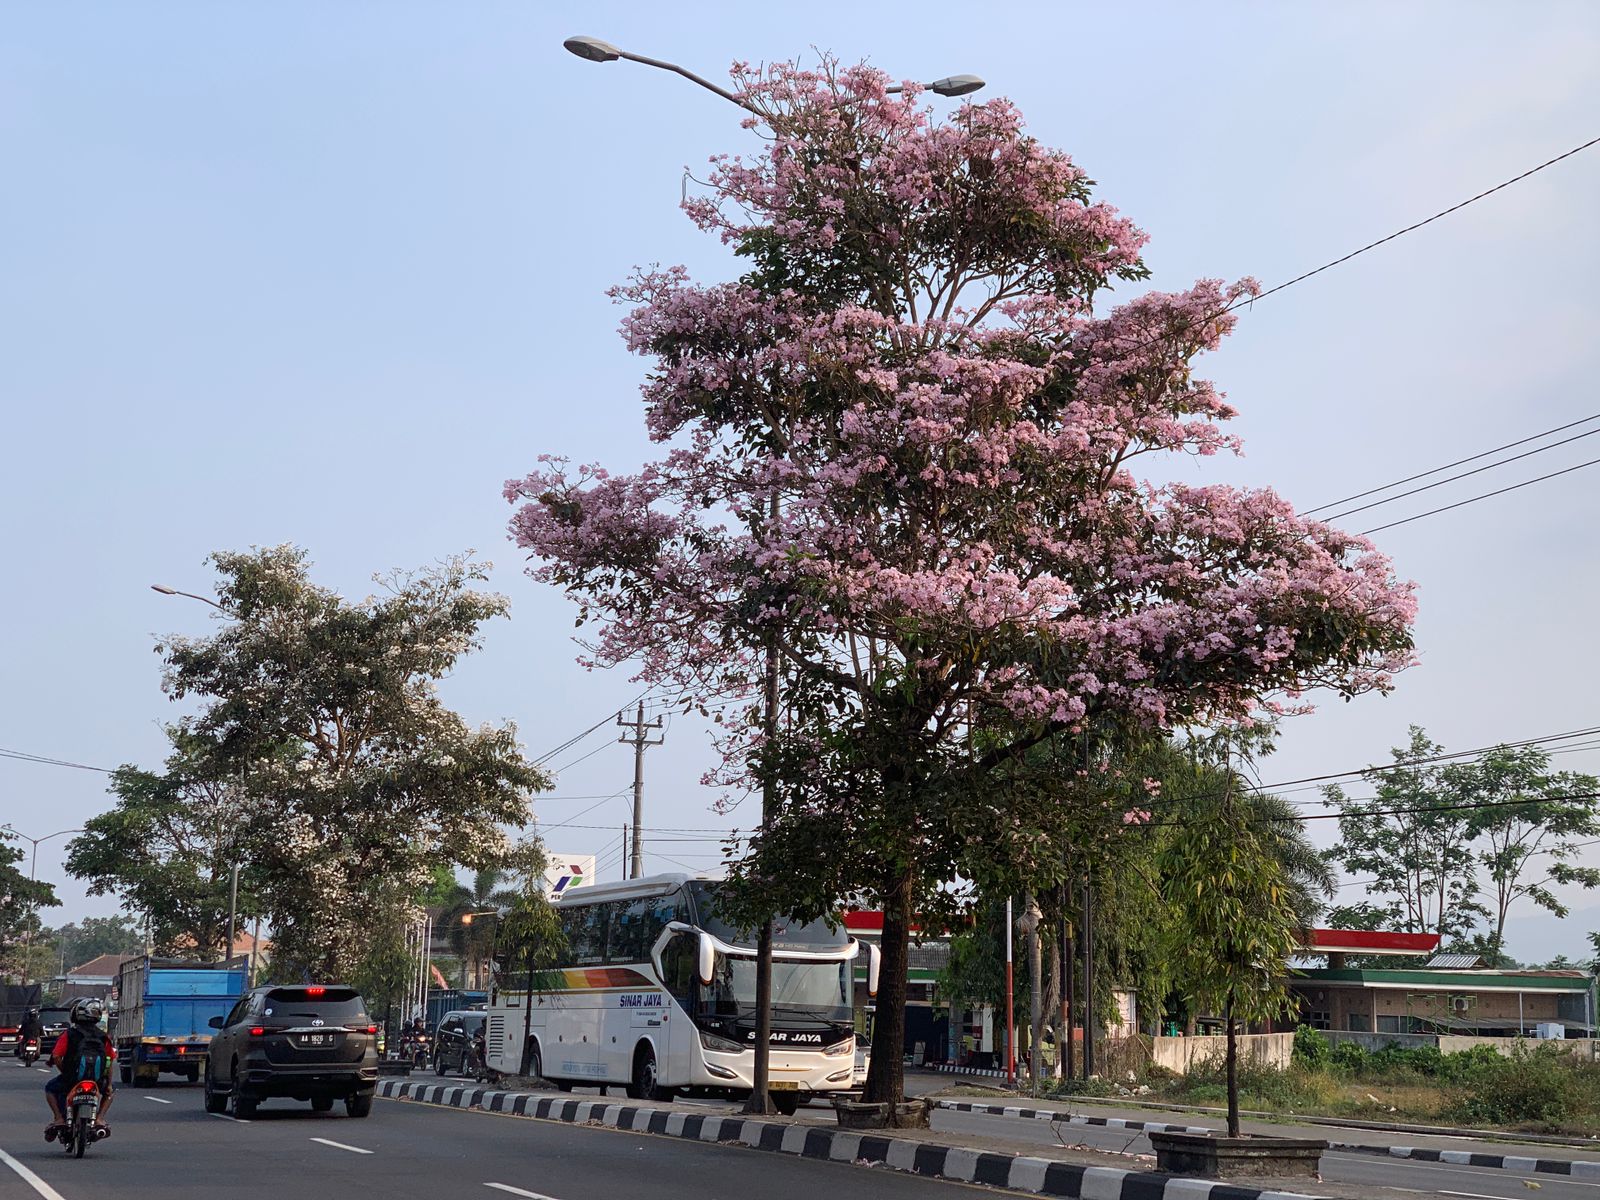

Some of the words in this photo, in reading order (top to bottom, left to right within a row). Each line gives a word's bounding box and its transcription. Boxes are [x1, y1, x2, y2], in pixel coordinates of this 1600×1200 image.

[619, 994, 642, 1007] SINAR
[643, 994, 662, 1007] JAYA
[301, 1034, 309, 1042] AA
[747, 1031, 788, 1041] SAR
[790, 1033, 822, 1043] JAYA
